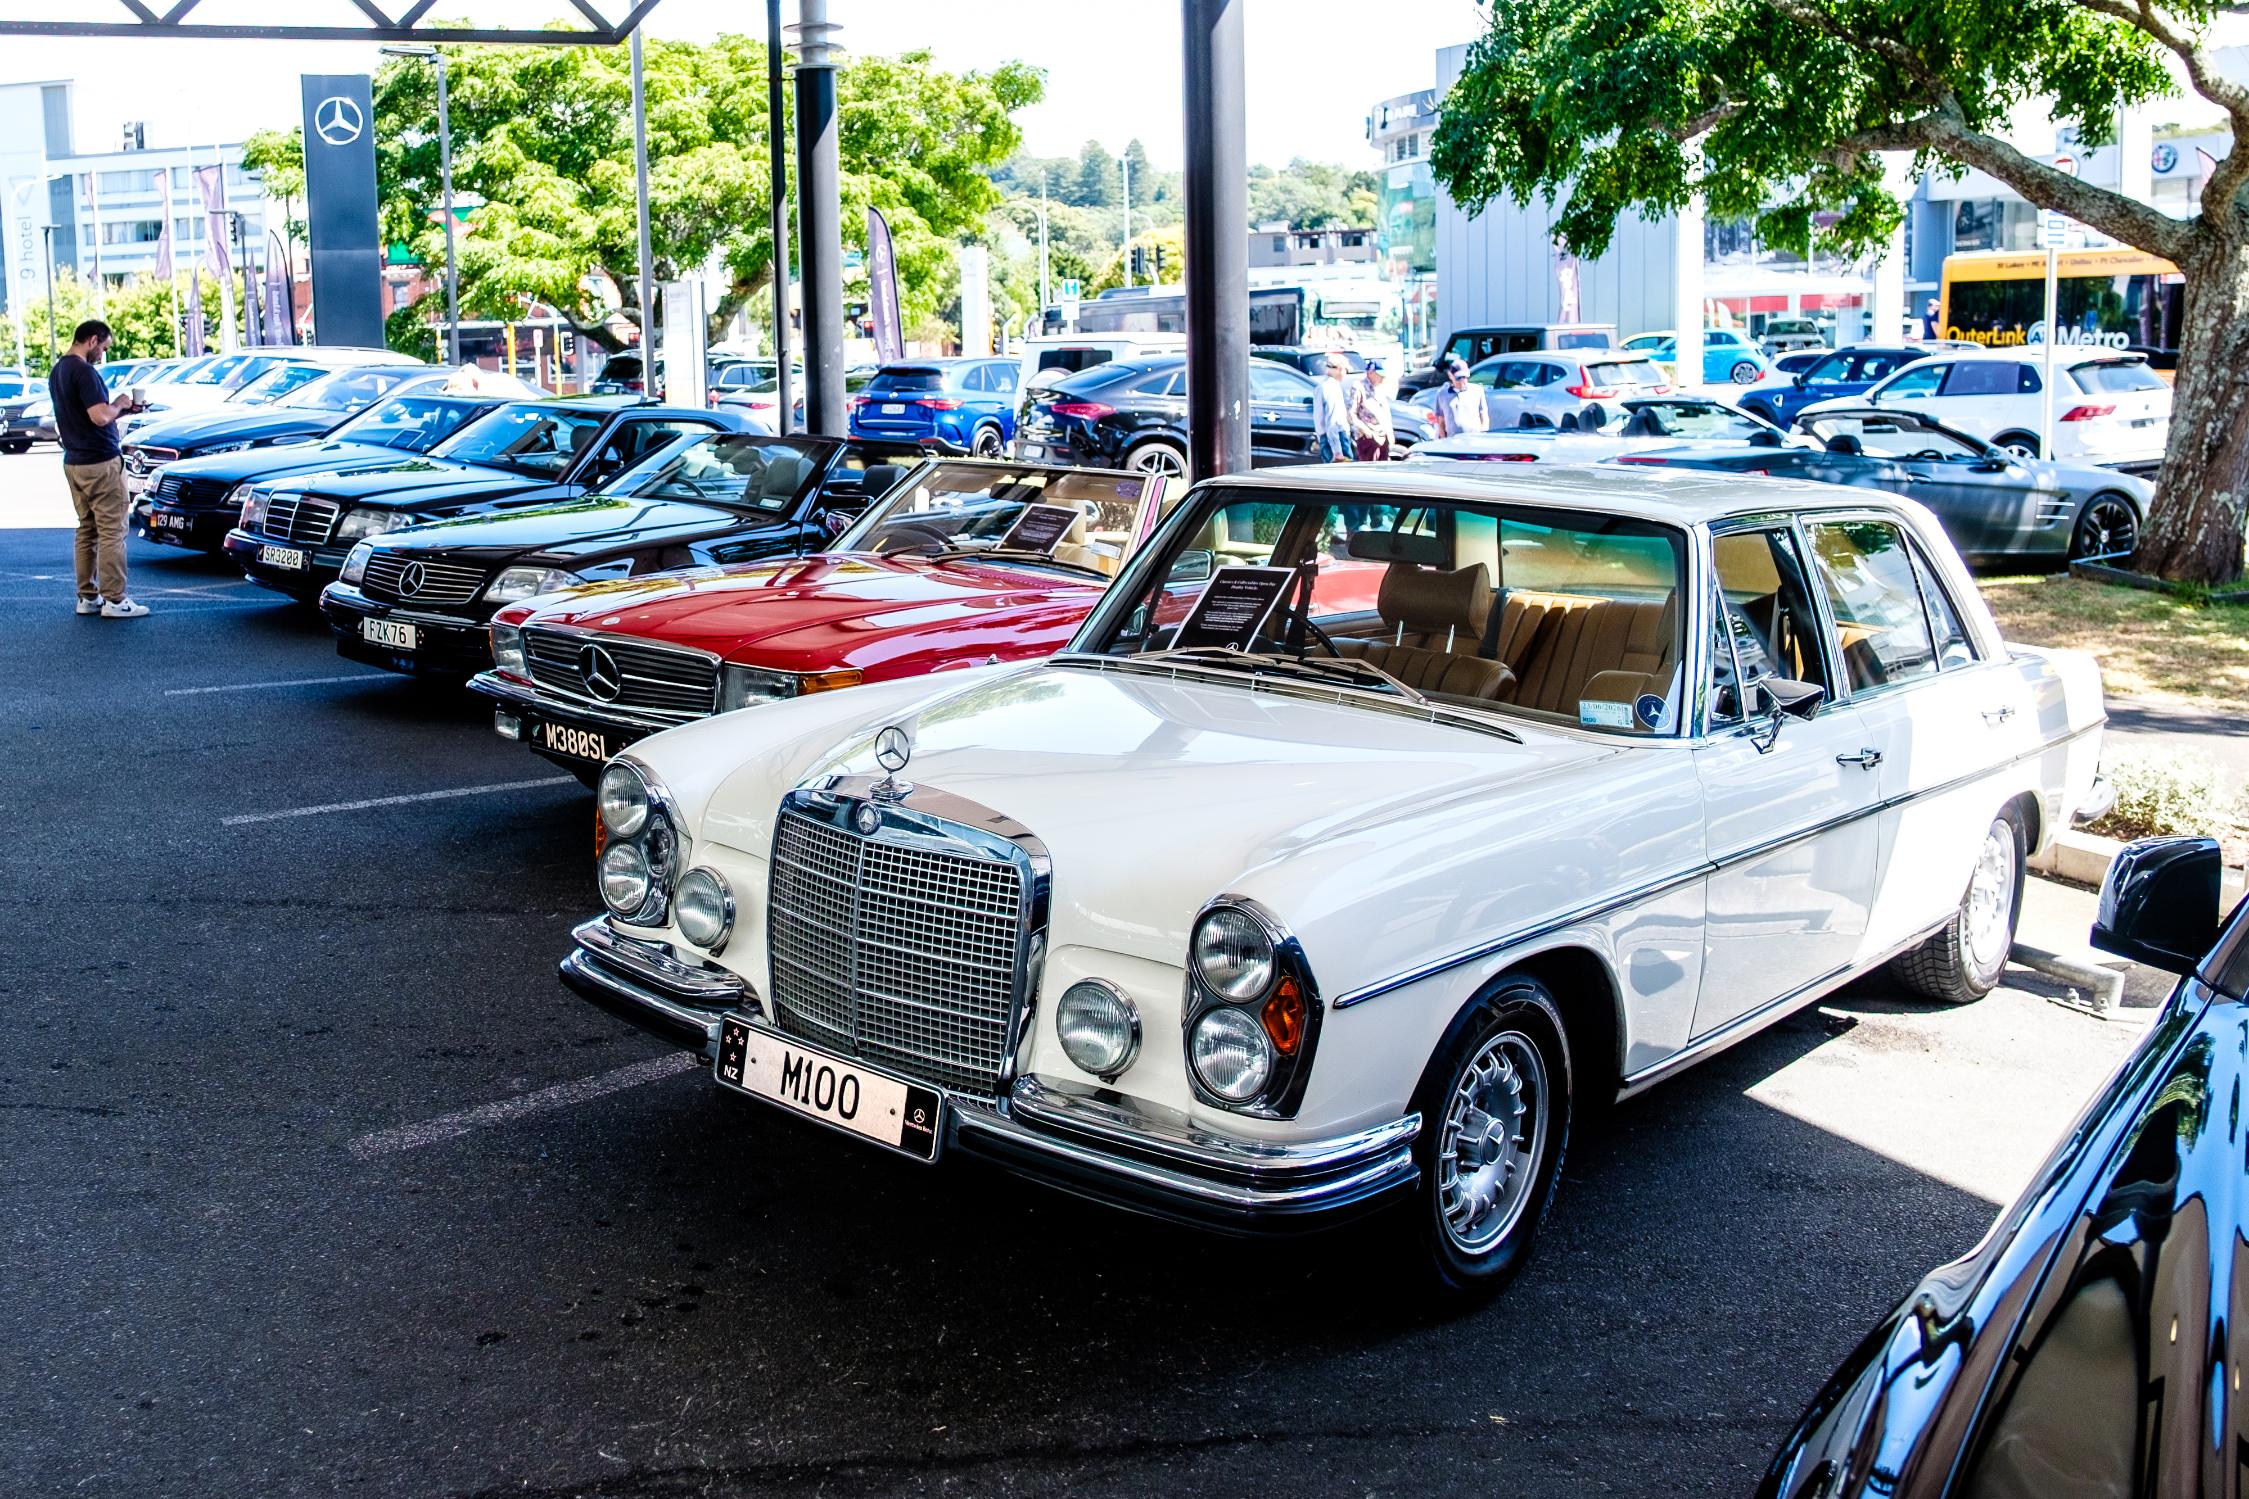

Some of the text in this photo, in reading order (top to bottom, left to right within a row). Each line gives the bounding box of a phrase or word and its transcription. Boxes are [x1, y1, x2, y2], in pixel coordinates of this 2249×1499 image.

[17, 216, 33, 262] hotel
[1946, 323, 2026, 345] OuterLink
[2057, 326, 2130, 350] Metro
[157, 513, 185, 530] 129 AMG
[265, 546, 299, 566] SR3200
[369, 620, 407, 645] FZK76
[545, 721, 609, 763] M380SL
[723, 1064, 738, 1081] NZ
[780, 1050, 860, 1120] M100
